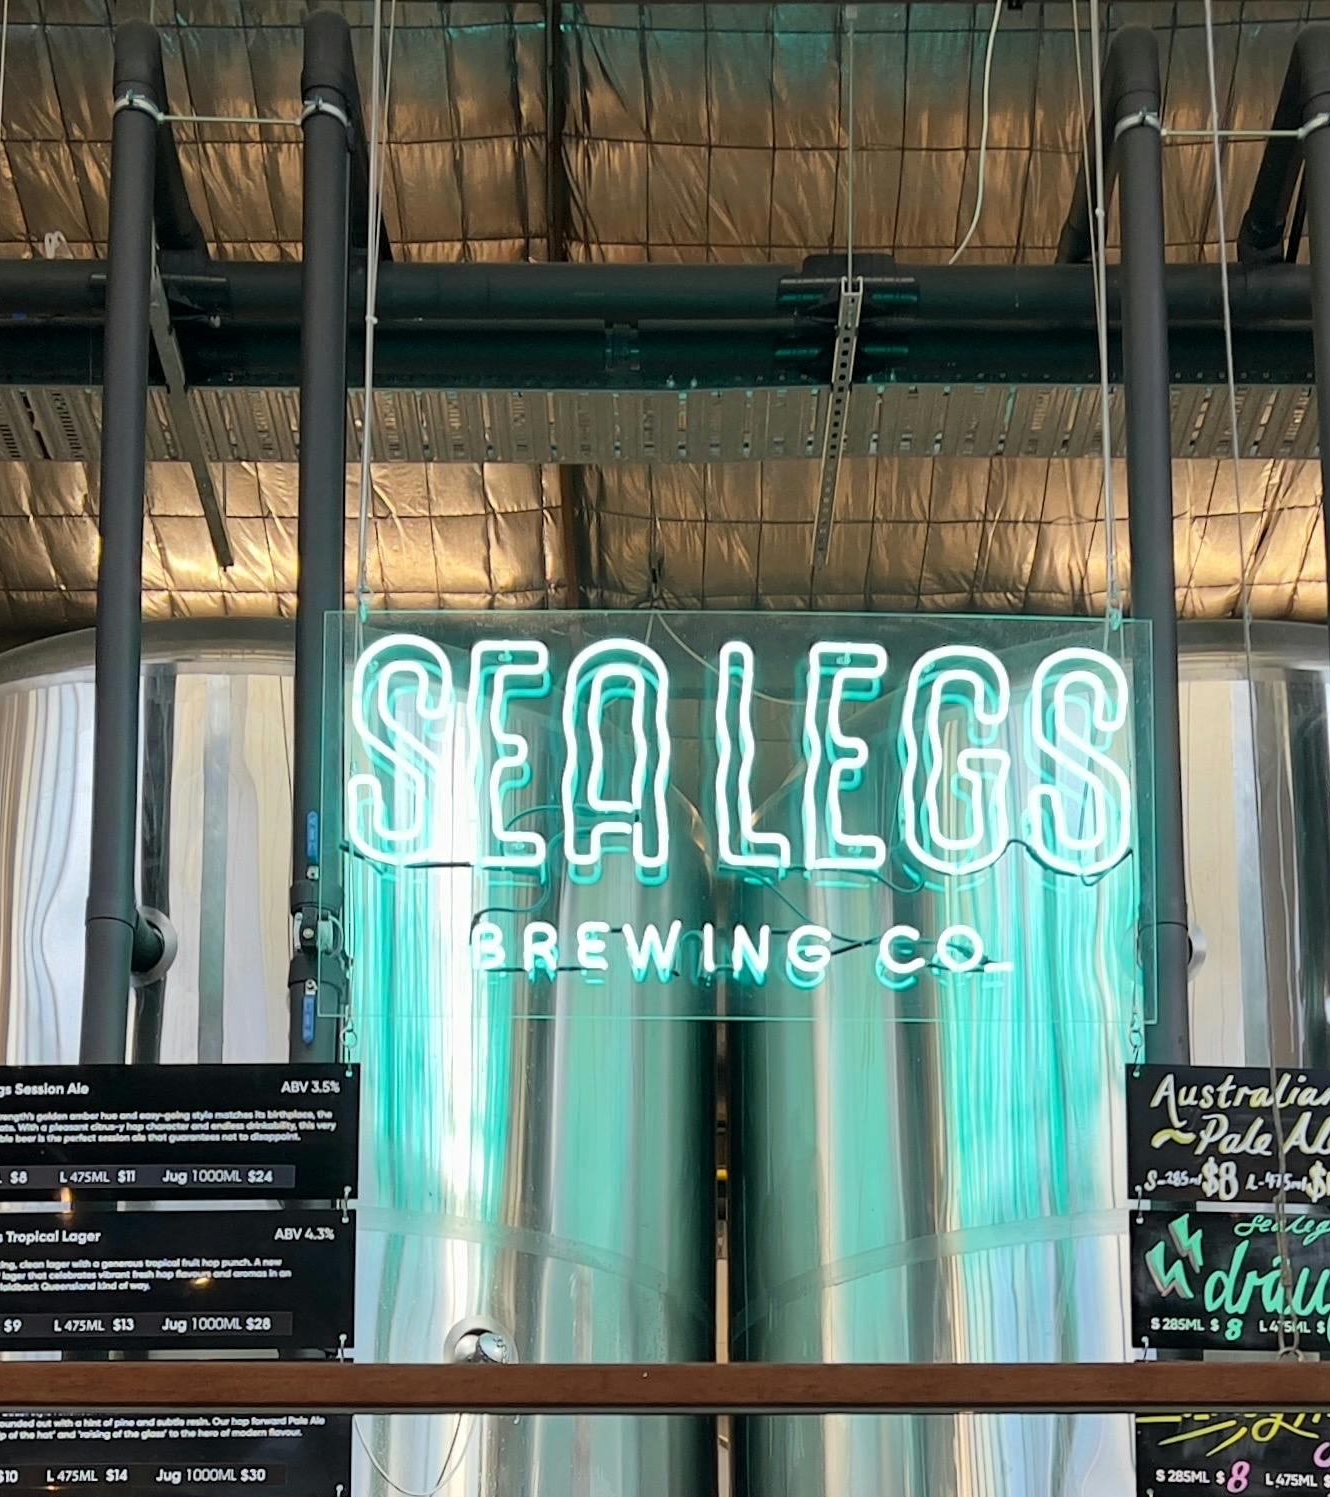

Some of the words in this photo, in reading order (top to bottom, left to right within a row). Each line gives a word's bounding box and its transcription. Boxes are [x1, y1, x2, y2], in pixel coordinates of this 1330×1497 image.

[346, 632, 670, 870] SEA
[716, 638, 1133, 876] LEGS
[470, 920, 833, 975] BREWING
[16, 1083, 64, 1095] Session
[67, 1082, 89, 1095] Ale
[281, 1081, 308, 1094] ABV
[311, 1081, 340, 1094] 3.5%
[1194, 1113, 1273, 1157] Pale
[10, 1170, 27, 1185] $8
[60, 1172, 67, 1184] L
[70, 1171, 110, 1184] 475ML
[117, 1169, 136, 1184] $11
[162, 1170, 187, 1186] Jug
[192, 1169, 242, 1182] 1000ML
[247, 1168, 273, 1184] $24
[6, 1231, 58, 1245] Tropical
[62, 1230, 101, 1245] Lager
[275, 1227, 302, 1241] ABV
[305, 1227, 335, 1240] 4.3%
[4, 1318, 21, 1334] $9
[54, 1320, 62, 1332] L
[64, 1319, 105, 1332] 475ML
[113, 1317, 134, 1332] $13
[161, 1318, 187, 1334] Jug
[192, 1317, 242, 1330] 1000ML
[245, 1316, 271, 1332] $28
[1151, 1319, 1160, 1331] S
[1162, 1318, 1205, 1332] 285ML
[1259, 1320, 1267, 1332] L
[1156, 1470, 1165, 1483] S
[1168, 1469, 1210, 1484] 285ML
[1265, 1472, 1274, 1486] L
[1276, 1472, 1317, 1488] 475ML
